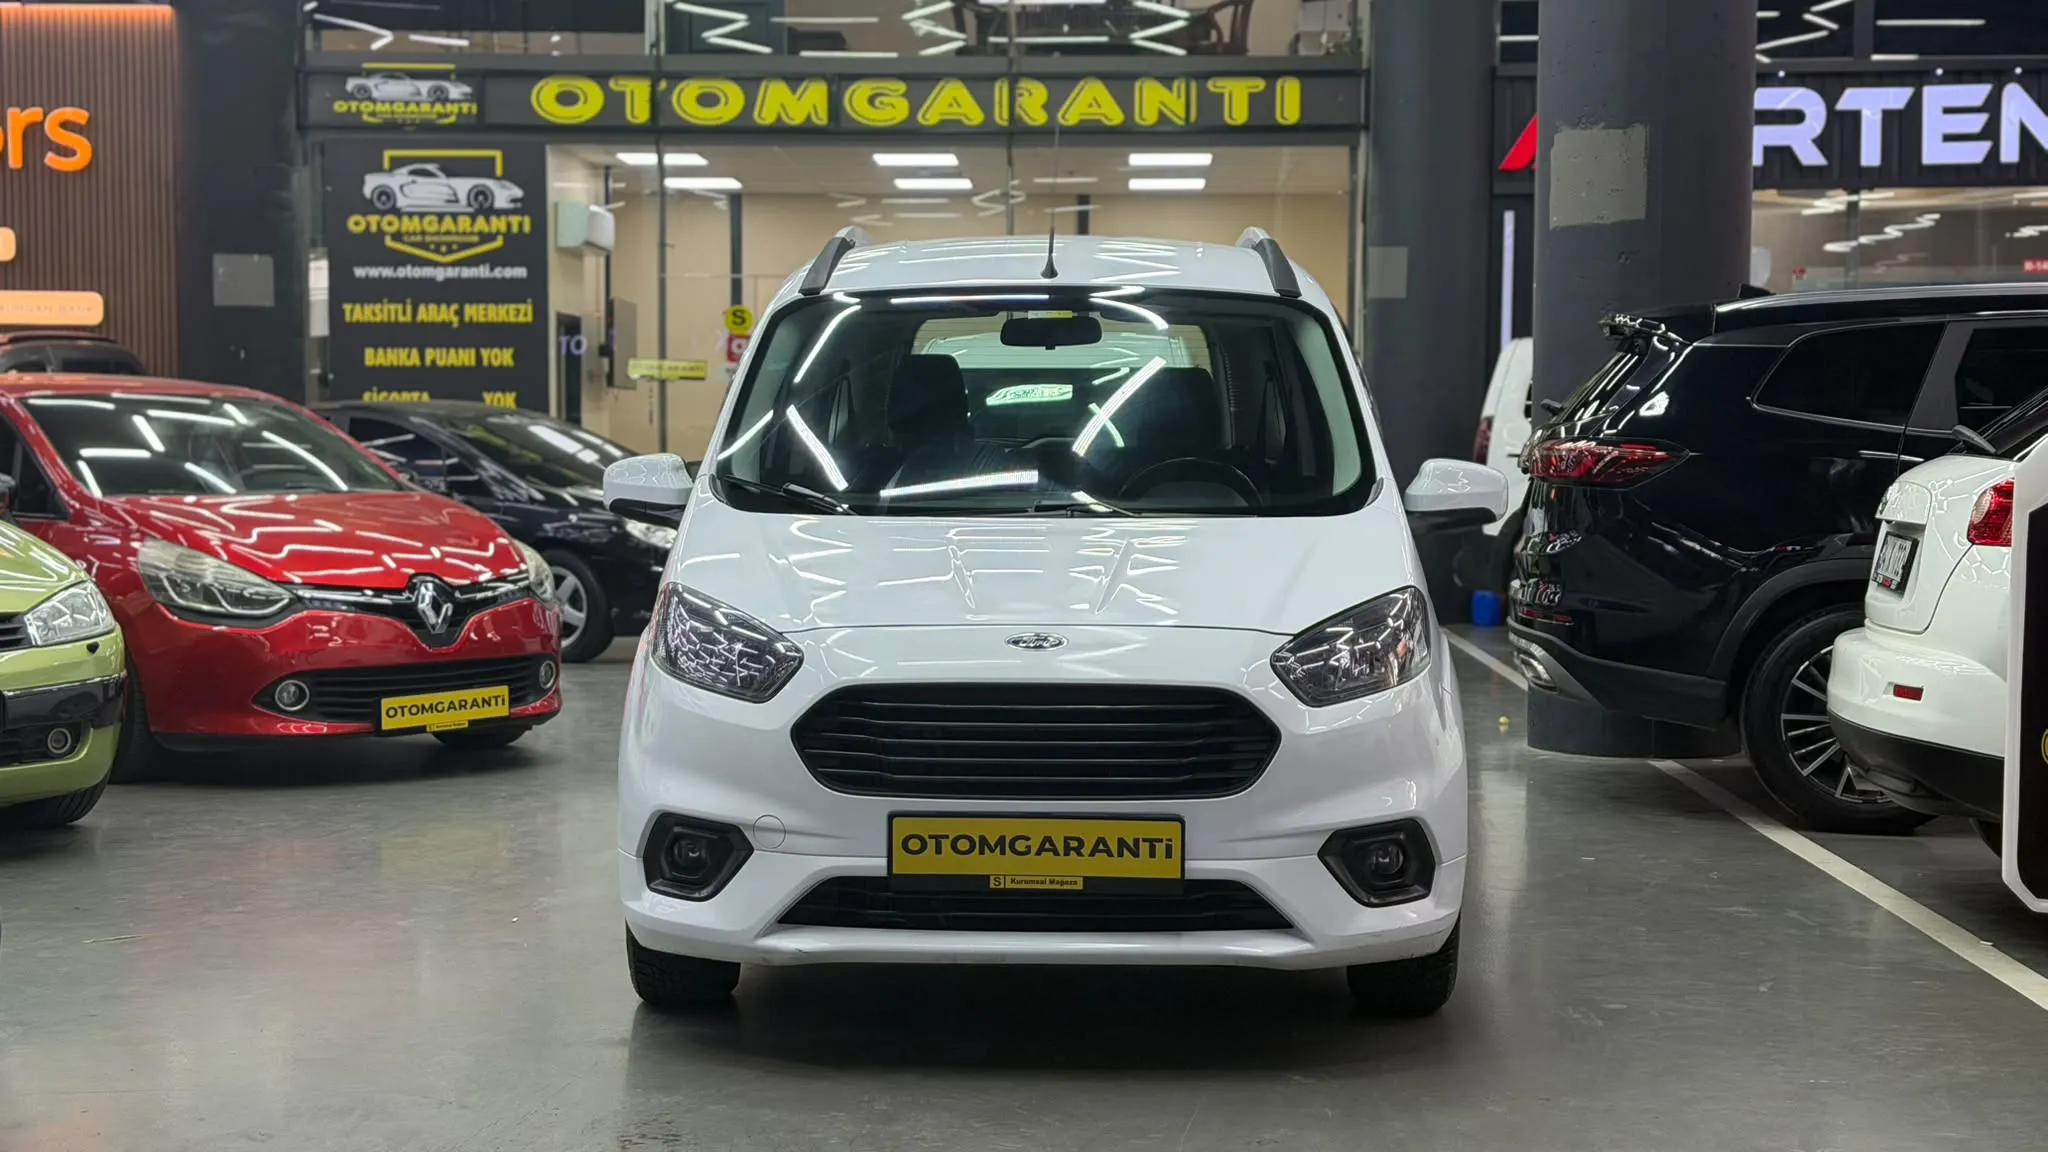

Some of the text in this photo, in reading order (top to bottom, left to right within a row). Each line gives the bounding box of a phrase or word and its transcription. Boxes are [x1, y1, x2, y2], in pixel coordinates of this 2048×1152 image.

[333, 101, 478, 115] OTOMGARANTI
[530, 74, 1301, 127] OTOMGARANTI
[0, 106, 93, 172] rs
[346, 214, 532, 234] OTOMGARANTI
[353, 264, 528, 282] www.otomgaranti.com
[342, 298, 534, 328] TAKSİTLİ ARAÇ MERKEZİ
[731, 308, 747, 327] S
[364, 346, 516, 367] BANKA PUANI YOK
[482, 391, 517, 409] YOK
[385, 695, 506, 718] OTOMGARANTi
[901, 833, 1174, 859] OTOMGARANTi
[992, 877, 1002, 887] S
[1010, 877, 1047, 885] Kurumsal
